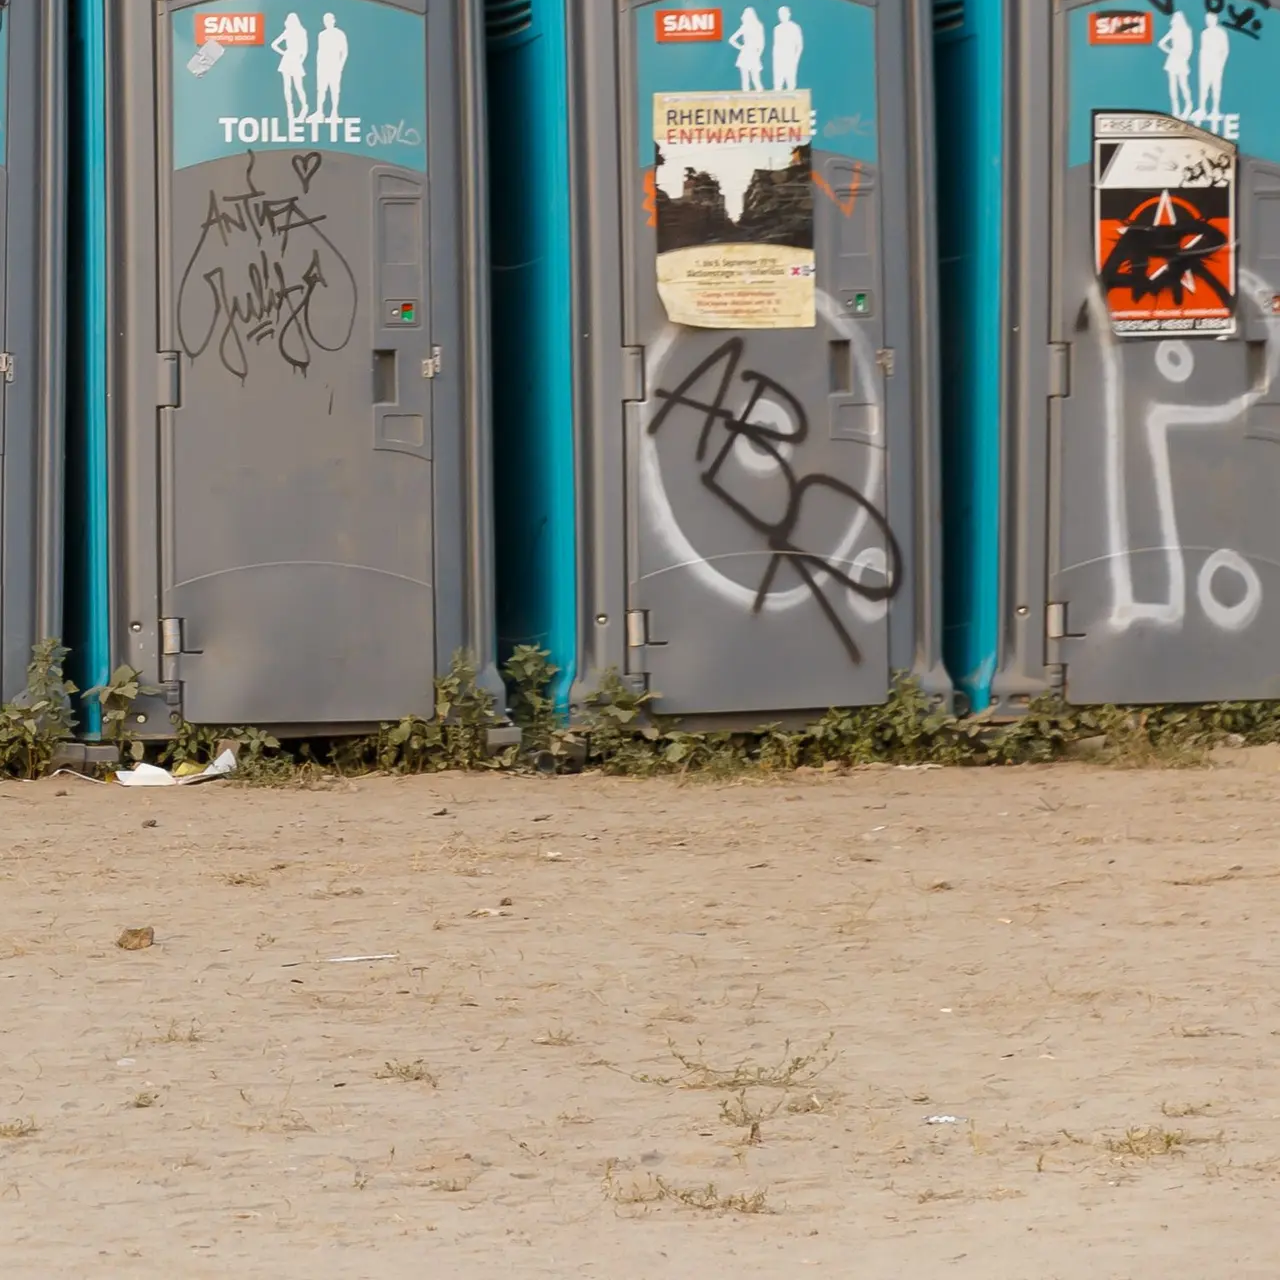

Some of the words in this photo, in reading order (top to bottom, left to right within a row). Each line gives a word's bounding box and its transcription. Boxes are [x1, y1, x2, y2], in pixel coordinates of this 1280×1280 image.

[204, 16, 256, 33] SANI
[663, 13, 715, 31] SANI
[666, 107, 801, 125] RHEINMETALL
[218, 116, 361, 143] TOILETTE
[667, 126, 802, 145] ENTWAFFNEN
